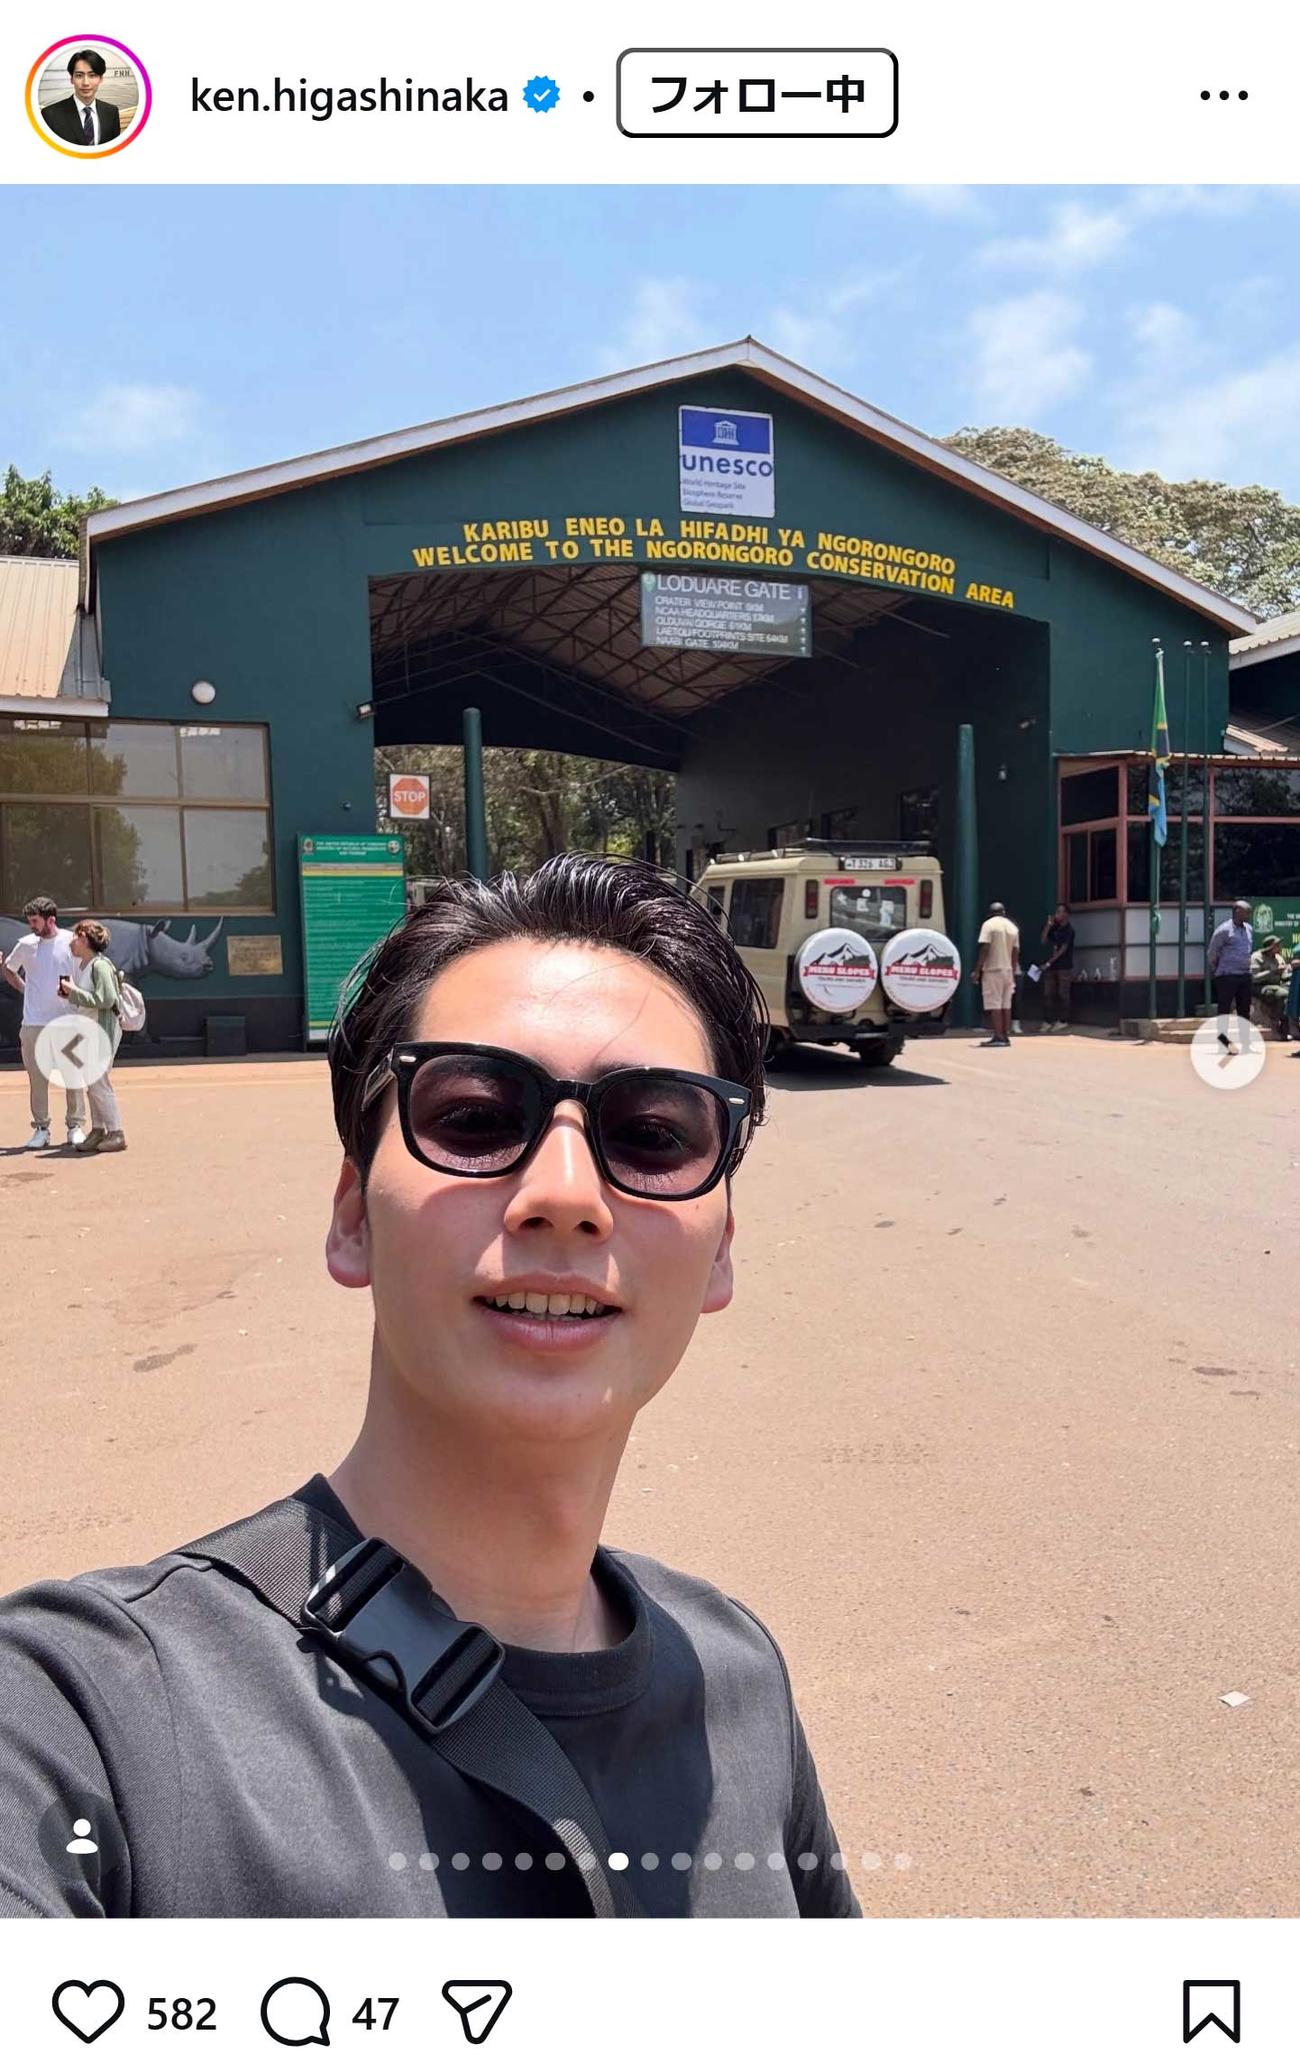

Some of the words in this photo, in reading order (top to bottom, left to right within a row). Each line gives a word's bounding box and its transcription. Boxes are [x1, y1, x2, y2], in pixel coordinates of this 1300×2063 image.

[682, 454, 773, 477] unesco
[463, 519, 549, 542] KARIBU
[565, 517, 626, 536] ENEO
[636, 518, 664, 536] LA
[680, 520, 769, 545] HIFADHI
[777, 528, 805, 548] YA
[818, 532, 955, 575] NGORONGORO
[411, 542, 534, 567] WELCOME
[545, 540, 579, 559] TO
[590, 539, 633, 557] THE
[646, 540, 793, 566] NGORONGORO
[806, 551, 955, 594] CONSERVATION
[965, 582, 1014, 608] AREA
[657, 574, 742, 597] LODUARE
[744, 580, 792, 600] GATE
[655, 595, 692, 607] CRATER
[682, 608, 752, 621] HEADQUARTERS
[694, 619, 727, 630] GORGE
[685, 639, 710, 649] GATE
[394, 791, 426, 802] STOP
